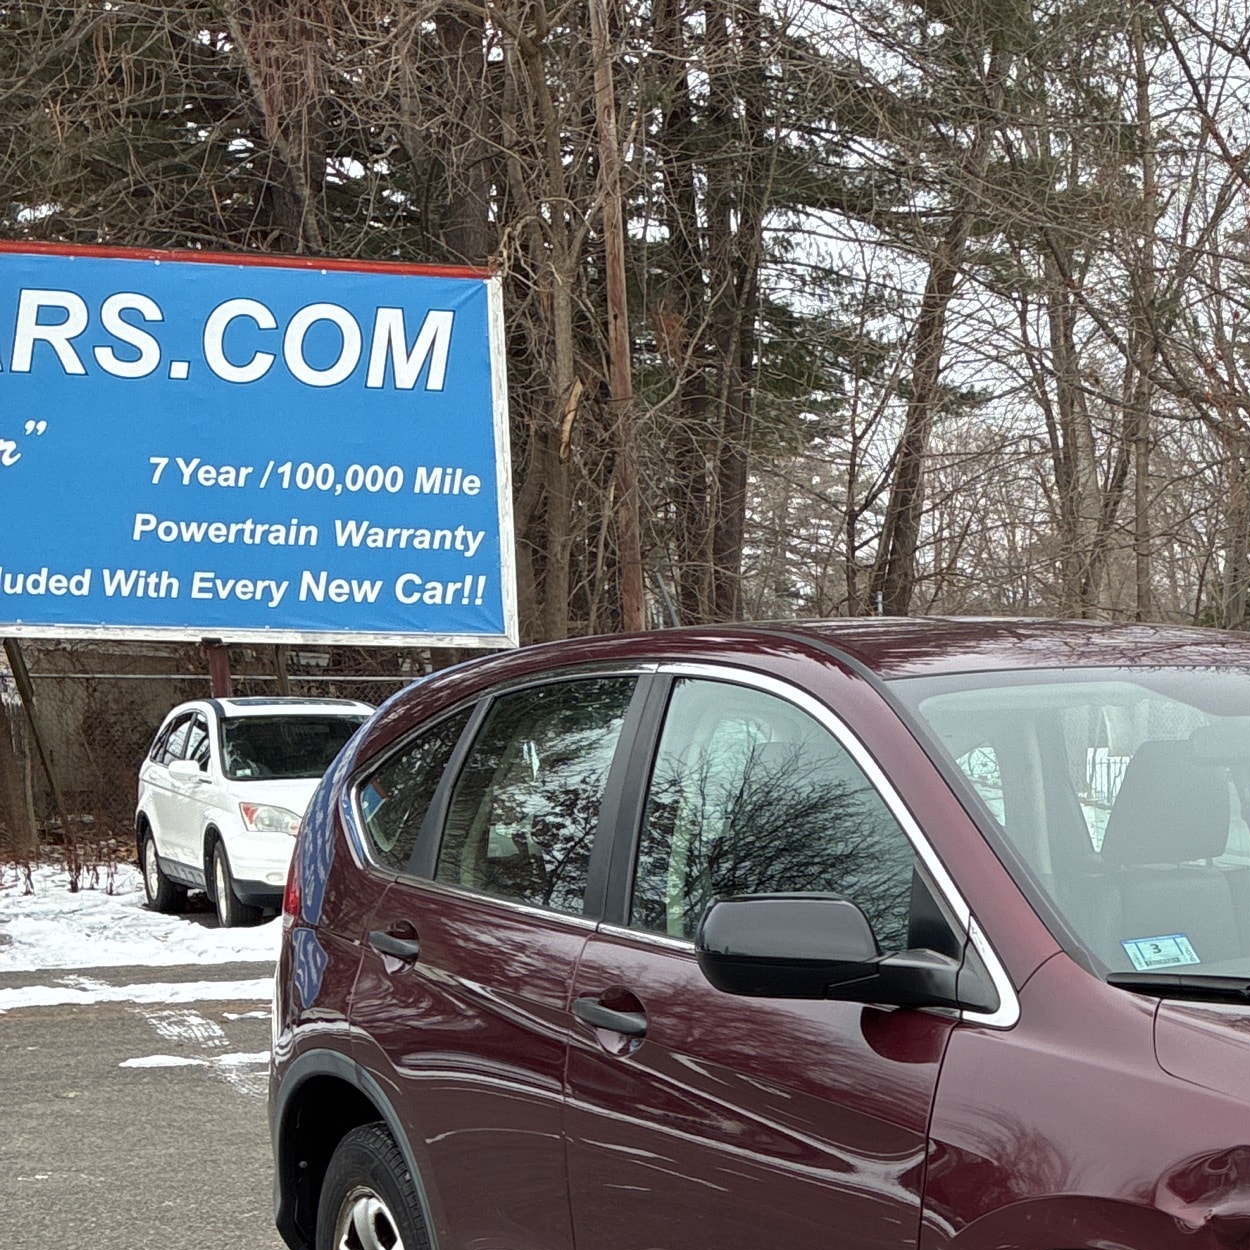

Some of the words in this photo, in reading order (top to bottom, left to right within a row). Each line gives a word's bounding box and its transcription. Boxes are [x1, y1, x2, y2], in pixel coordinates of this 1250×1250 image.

[0, 287, 456, 392] RS.COM
[149, 456, 170, 484] 7
[175, 457, 254, 488] Year
[413, 466, 482, 496] Mile
[133, 513, 318, 546] Powertrain
[335, 519, 485, 557] Warranty
[102, 569, 180, 598] With
[191, 571, 289, 608] Every
[299, 570, 383, 604] New
[395, 573, 487, 606] Car!!
[1149, 943, 1162, 954] 3
